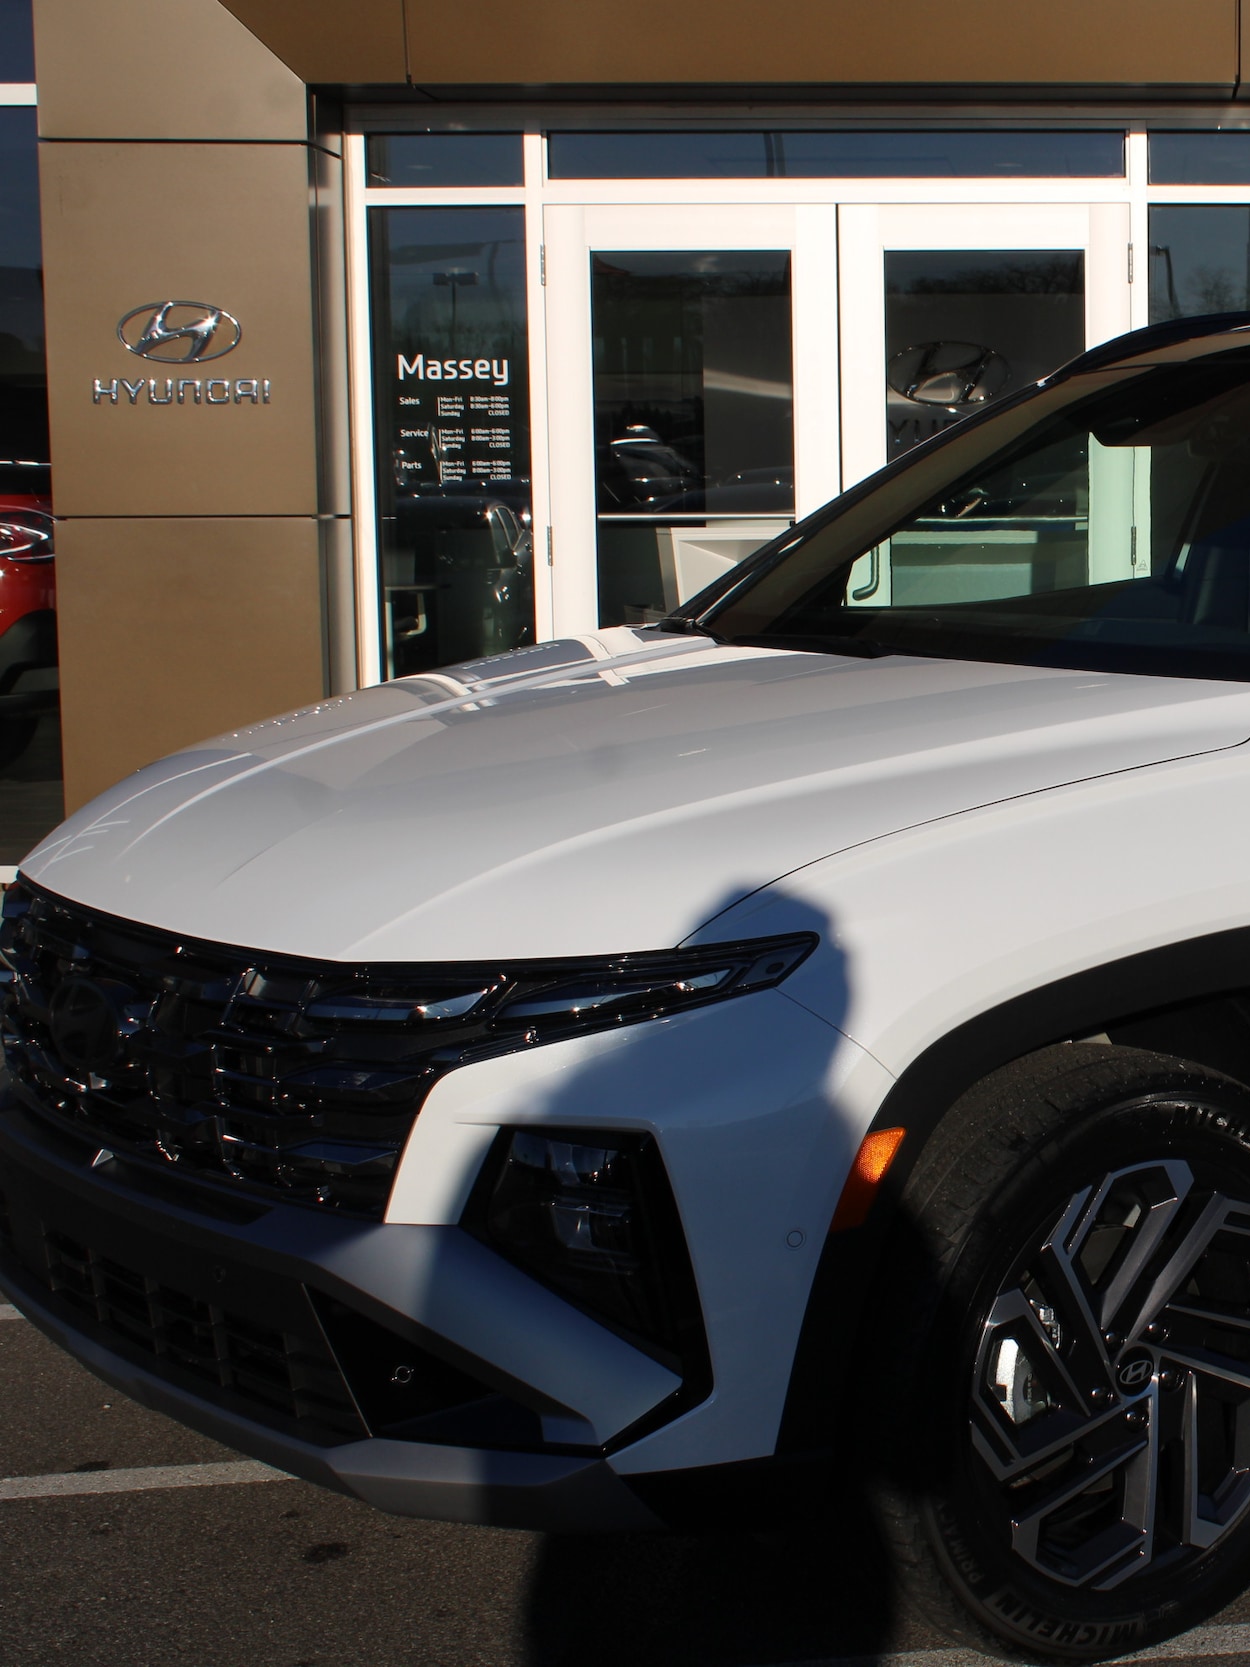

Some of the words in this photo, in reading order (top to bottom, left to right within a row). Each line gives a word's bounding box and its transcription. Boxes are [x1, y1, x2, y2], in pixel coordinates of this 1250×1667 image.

[397, 353, 510, 386] Massey
[92, 378, 271, 404] HYUNDAI
[399, 396, 421, 406] Sales
[400, 428, 429, 438] Service
[401, 461, 422, 469] Parts
[994, 1591, 1139, 1646] MICHELIN
